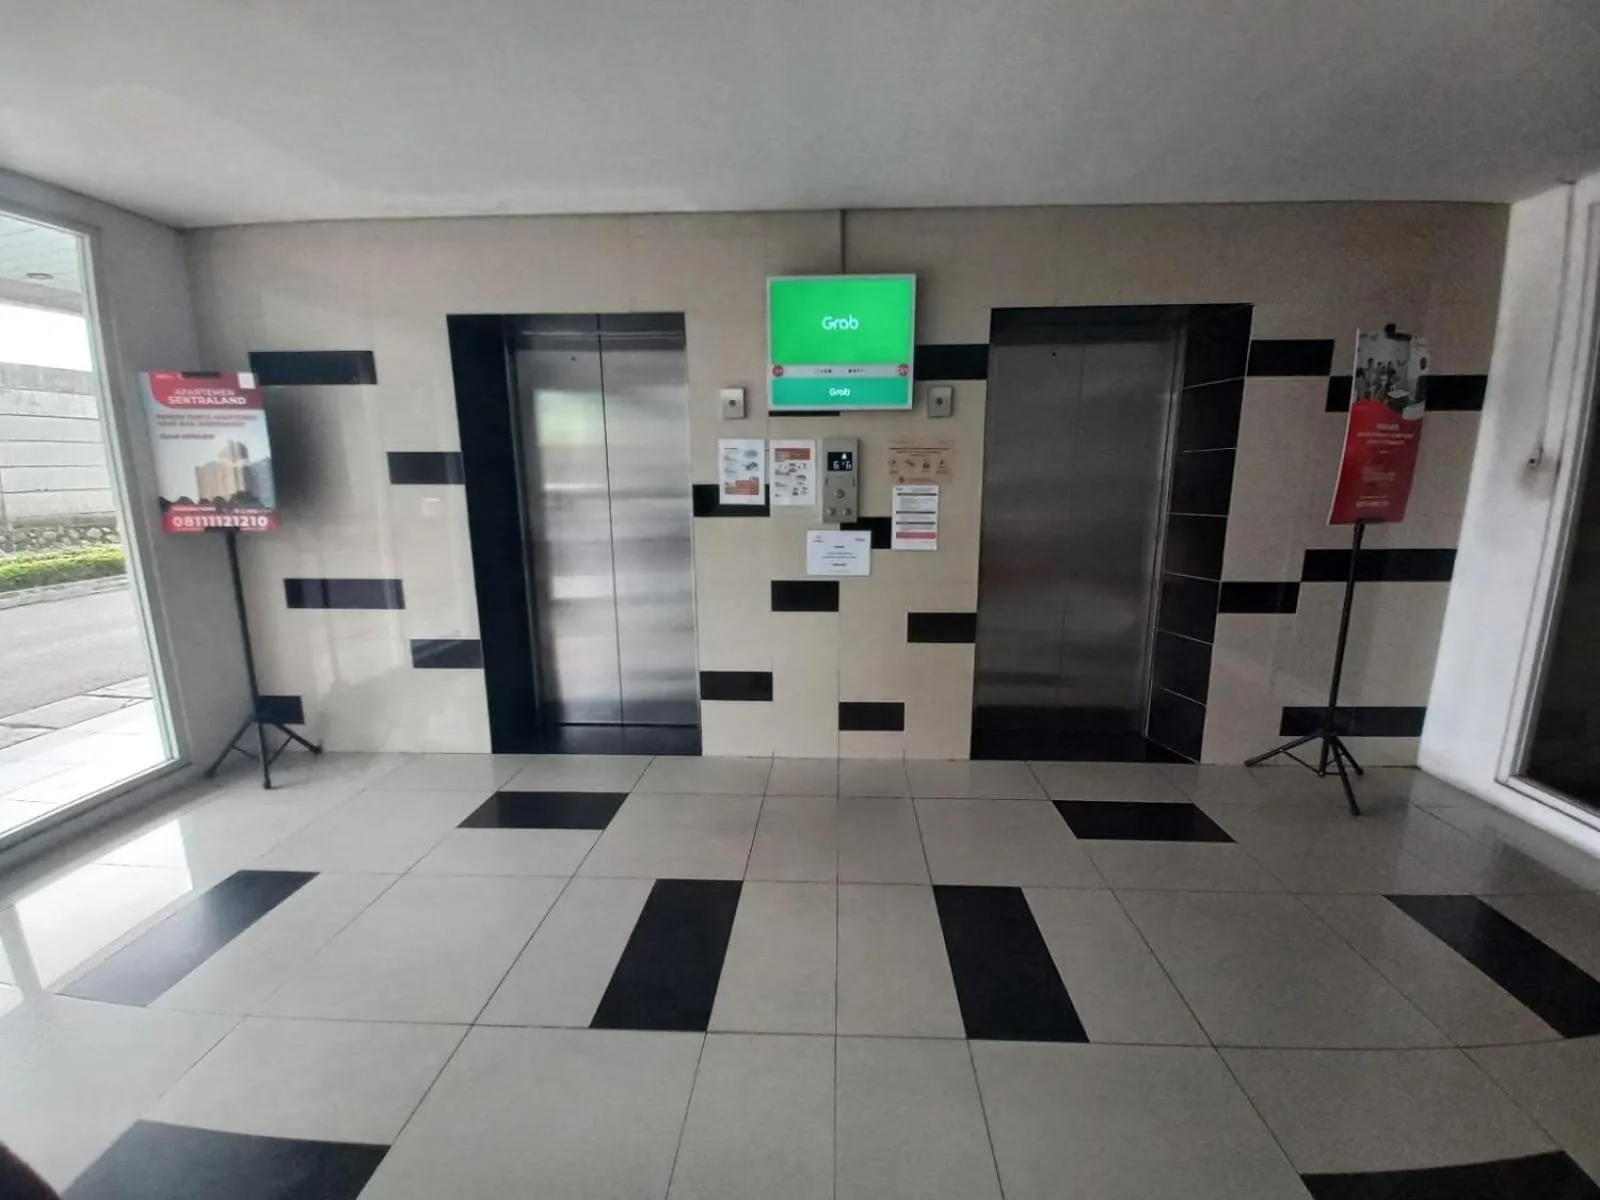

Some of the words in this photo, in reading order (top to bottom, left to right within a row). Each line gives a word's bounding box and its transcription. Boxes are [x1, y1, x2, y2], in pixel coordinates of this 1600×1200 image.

[821, 314, 859, 331] Grab
[828, 387, 851, 397] Grab
[167, 395, 248, 406] SENTRALAND
[171, 515, 269, 528] 08111121210
